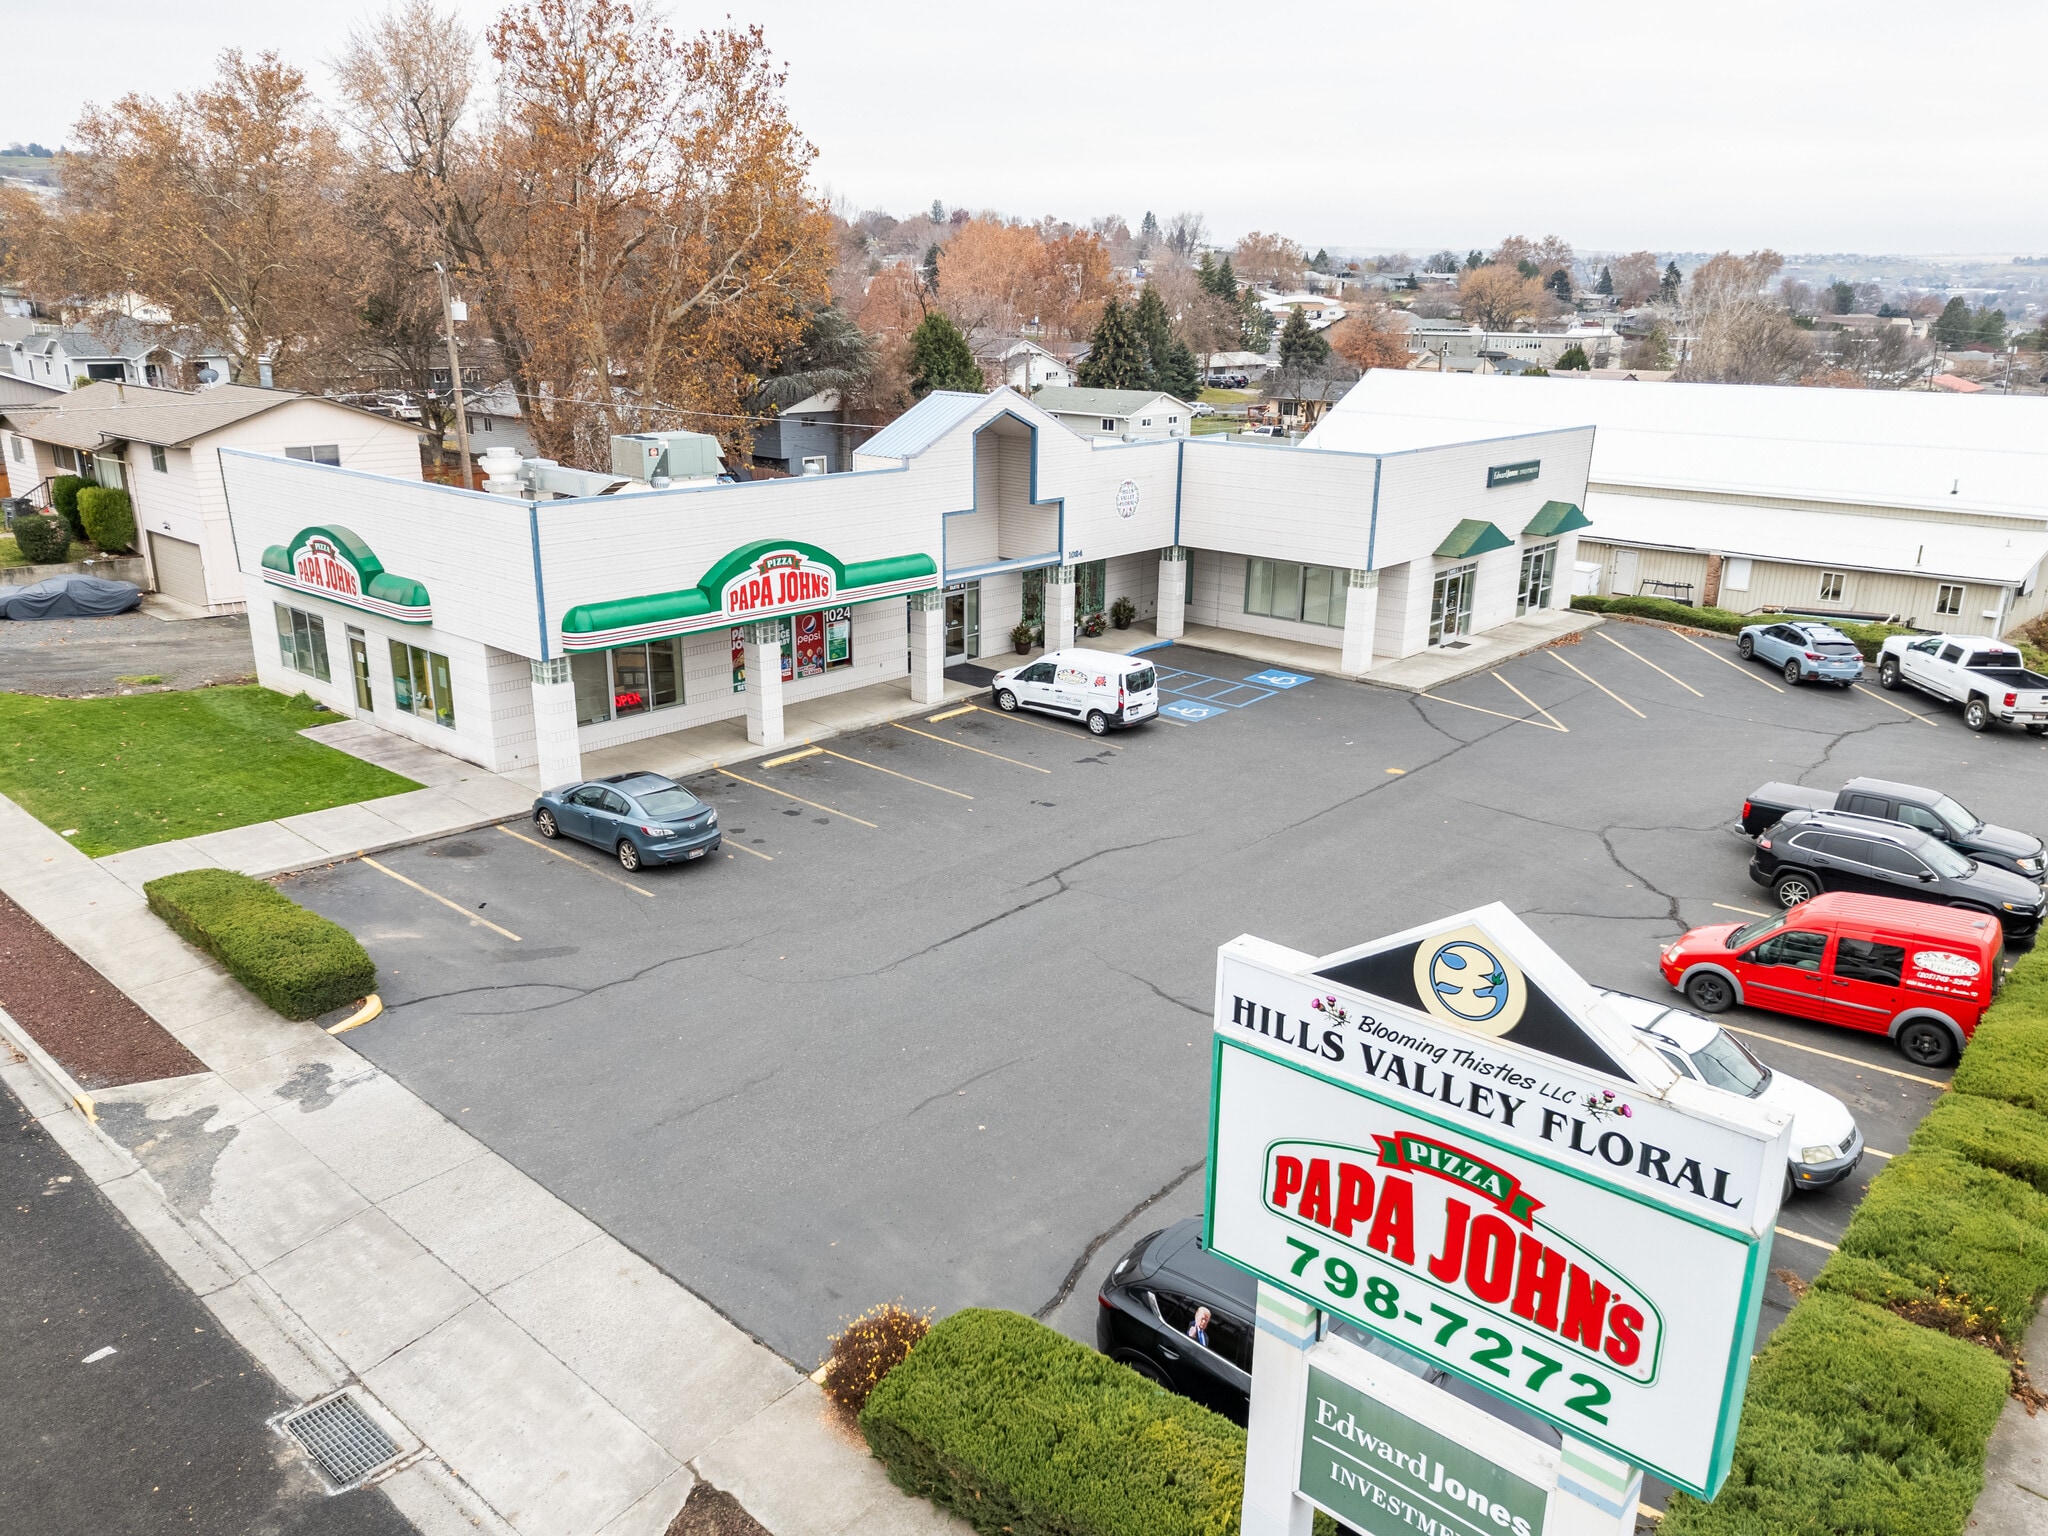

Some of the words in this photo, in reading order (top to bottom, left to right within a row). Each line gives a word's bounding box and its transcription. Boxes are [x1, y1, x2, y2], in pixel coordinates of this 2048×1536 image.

[298, 557, 324, 586] PAPA
[766, 557, 793, 568] PIZZA
[730, 576, 773, 612] PAPA
[824, 607, 851, 622] 1024
[797, 631, 821, 645] pepsi
[614, 692, 642, 707] OPEN
[1357, 1015, 1448, 1064] Blooming
[1447, 1048, 1536, 1090] Thistles
[1539, 1083, 1576, 1104] LLC
[1232, 995, 1345, 1062] HILLS
[1360, 1042, 1526, 1128] VALLEY
[1539, 1107, 1743, 1209] FLORAL
[1408, 1141, 1502, 1197] PIZZA
[1272, 1155, 1416, 1265] PAPA
[1428, 1197, 1644, 1366] JOHN'S
[1285, 1236, 1612, 1426] 798-7272
